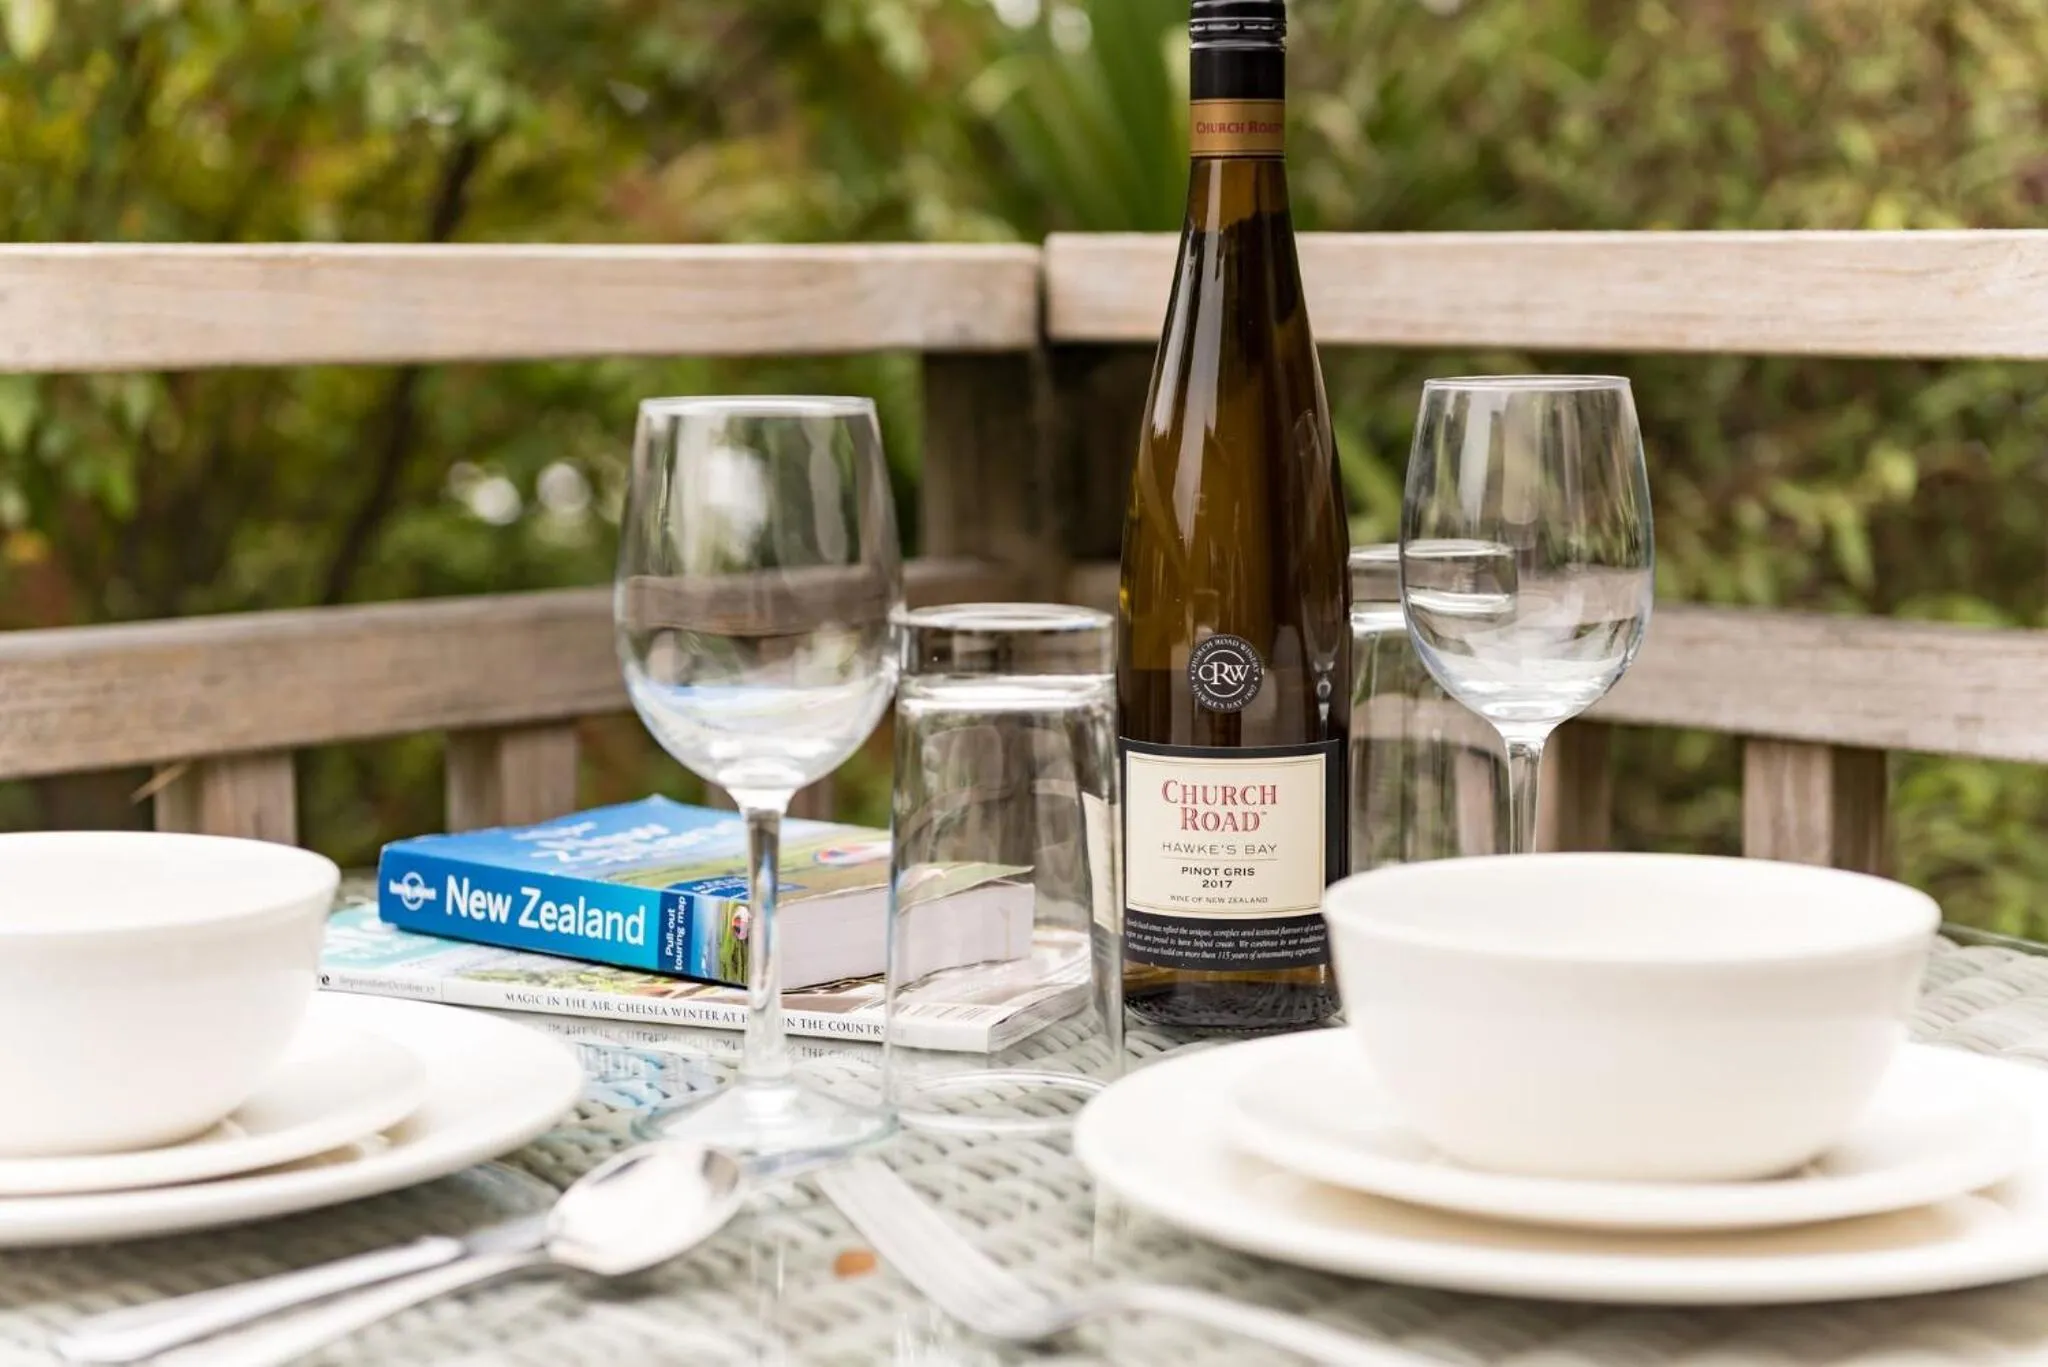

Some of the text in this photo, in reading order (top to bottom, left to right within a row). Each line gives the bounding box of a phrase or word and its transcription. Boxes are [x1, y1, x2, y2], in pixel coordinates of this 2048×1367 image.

[1196, 121, 1244, 134] CHURCH
[1214, 639, 1239, 647] ROAD
[1198, 661, 1250, 685] CRW
[1161, 779, 1277, 806] CHURCH
[1162, 841, 1277, 855] HAWKE'S BAY
[1181, 866, 1255, 877] PINOT GRIS
[1202, 879, 1233, 889] 2017
[1170, 895, 1189, 903] WINE
[1205, 896, 1225, 904] NEW
[1228, 896, 1268, 904] ZEALAND
[445, 874, 646, 946] New Zealand
[665, 908, 676, 956] Pull-out
[674, 896, 687, 971] touring map
[505, 993, 542, 1005] MAGIC
[547, 996, 560, 1006] IN
[565, 997, 586, 1009] THE
[617, 1002, 669, 1017] CHELSEA
[670, 1007, 719, 1021] WINTER
[723, 1012, 737, 1023] AT
[800, 1018, 825, 1031] THE
